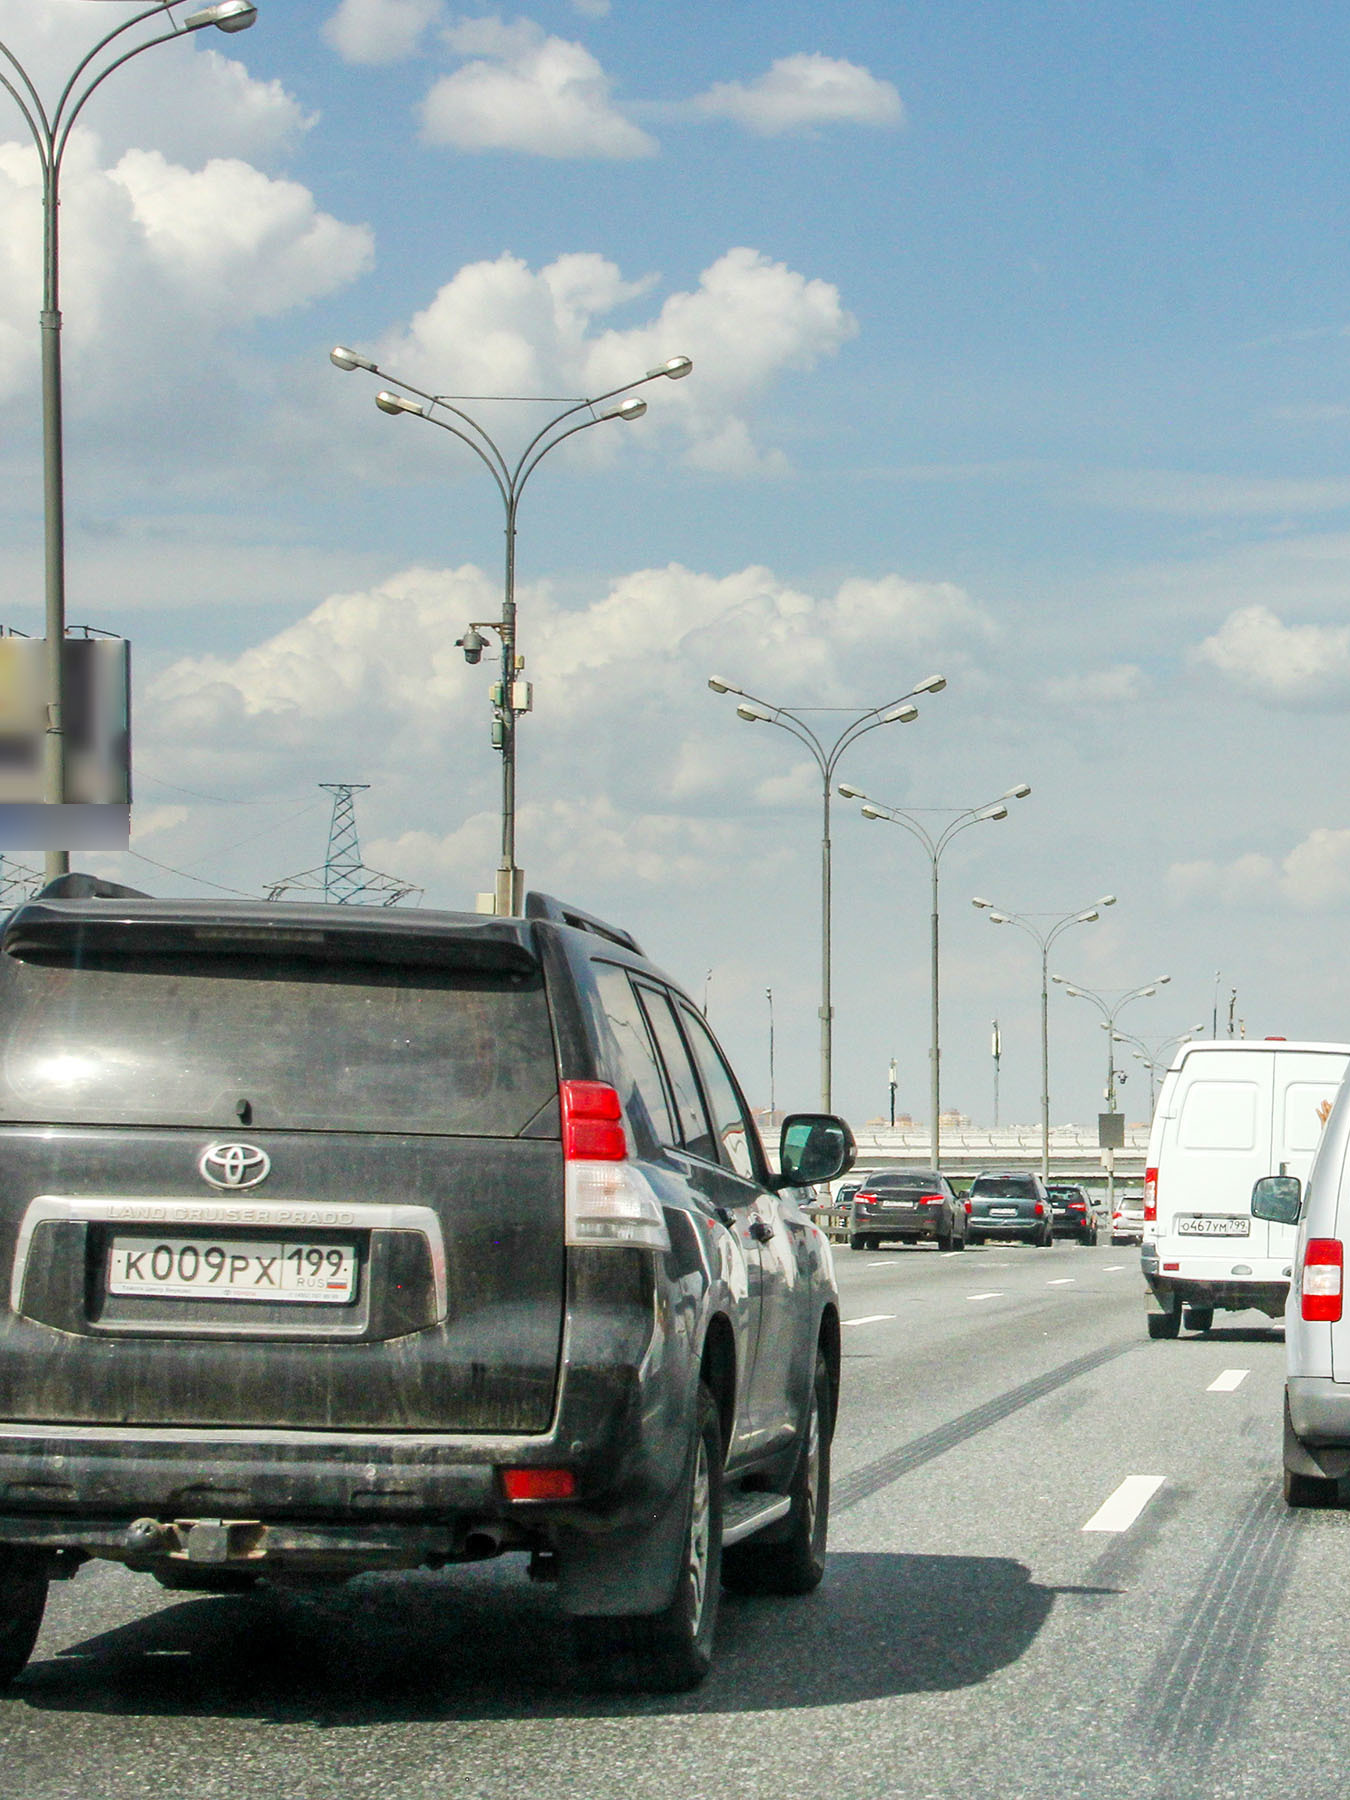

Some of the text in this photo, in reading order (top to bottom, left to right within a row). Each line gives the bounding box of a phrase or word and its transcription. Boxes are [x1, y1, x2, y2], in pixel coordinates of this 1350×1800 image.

[106, 1205, 355, 1225] LAND CRUISER PRADO
[125, 1244, 344, 1285] К009РХ 199
[297, 1277, 325, 1289] RUS
